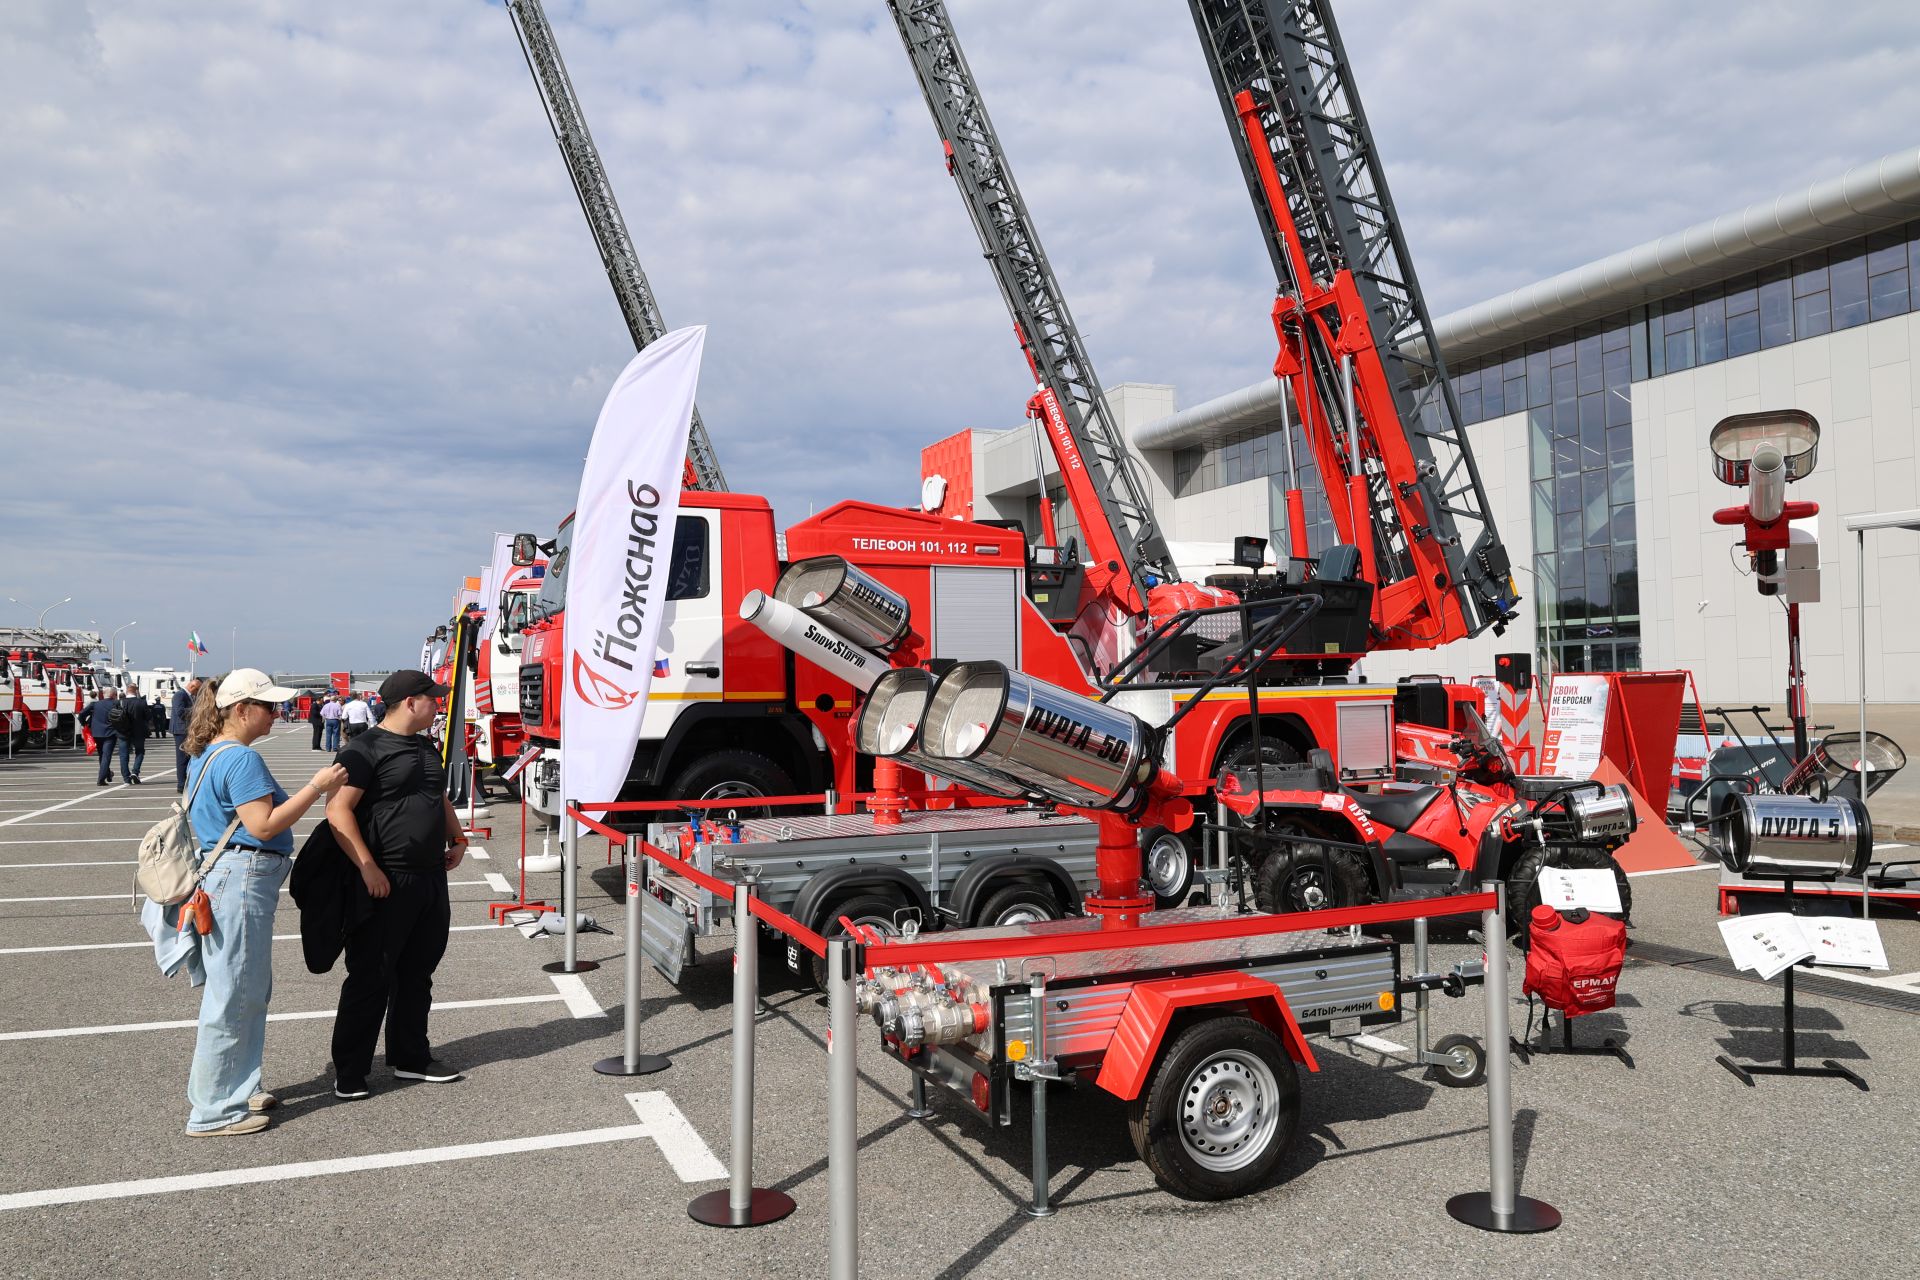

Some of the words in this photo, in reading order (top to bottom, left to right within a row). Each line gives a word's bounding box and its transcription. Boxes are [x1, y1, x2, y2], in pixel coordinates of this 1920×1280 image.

[1043, 390, 1066, 434] ТЕЛЕФОН
[1061, 435, 1073, 454] 101,
[1069, 454, 1080, 470] 112
[852, 537, 916, 552] ТЕЛЕФОН
[920, 542, 944, 554] 101,
[948, 543, 967, 554] 112
[602, 479, 661, 671] Пожснаб
[852, 582, 885, 610] ПУРГА
[884, 600, 904, 620] 120
[804, 624, 867, 669] SnowStorm
[1552, 696, 1561, 705] НЕ
[1562, 696, 1592, 705] БРОСАЕМ
[1554, 685, 1579, 696] СВОИХ
[1024, 705, 1093, 751] ПУРГА
[1097, 734, 1128, 763] 50
[1347, 802, 1375, 836] ПУРГА
[1592, 822, 1617, 833] ПУРГА
[1760, 817, 1819, 838] ПУРГА
[1828, 818, 1840, 838] 5
[1573, 975, 1617, 989] ЕРМАК
[1301, 1001, 1372, 1019] БАТЫР-МИНИ
